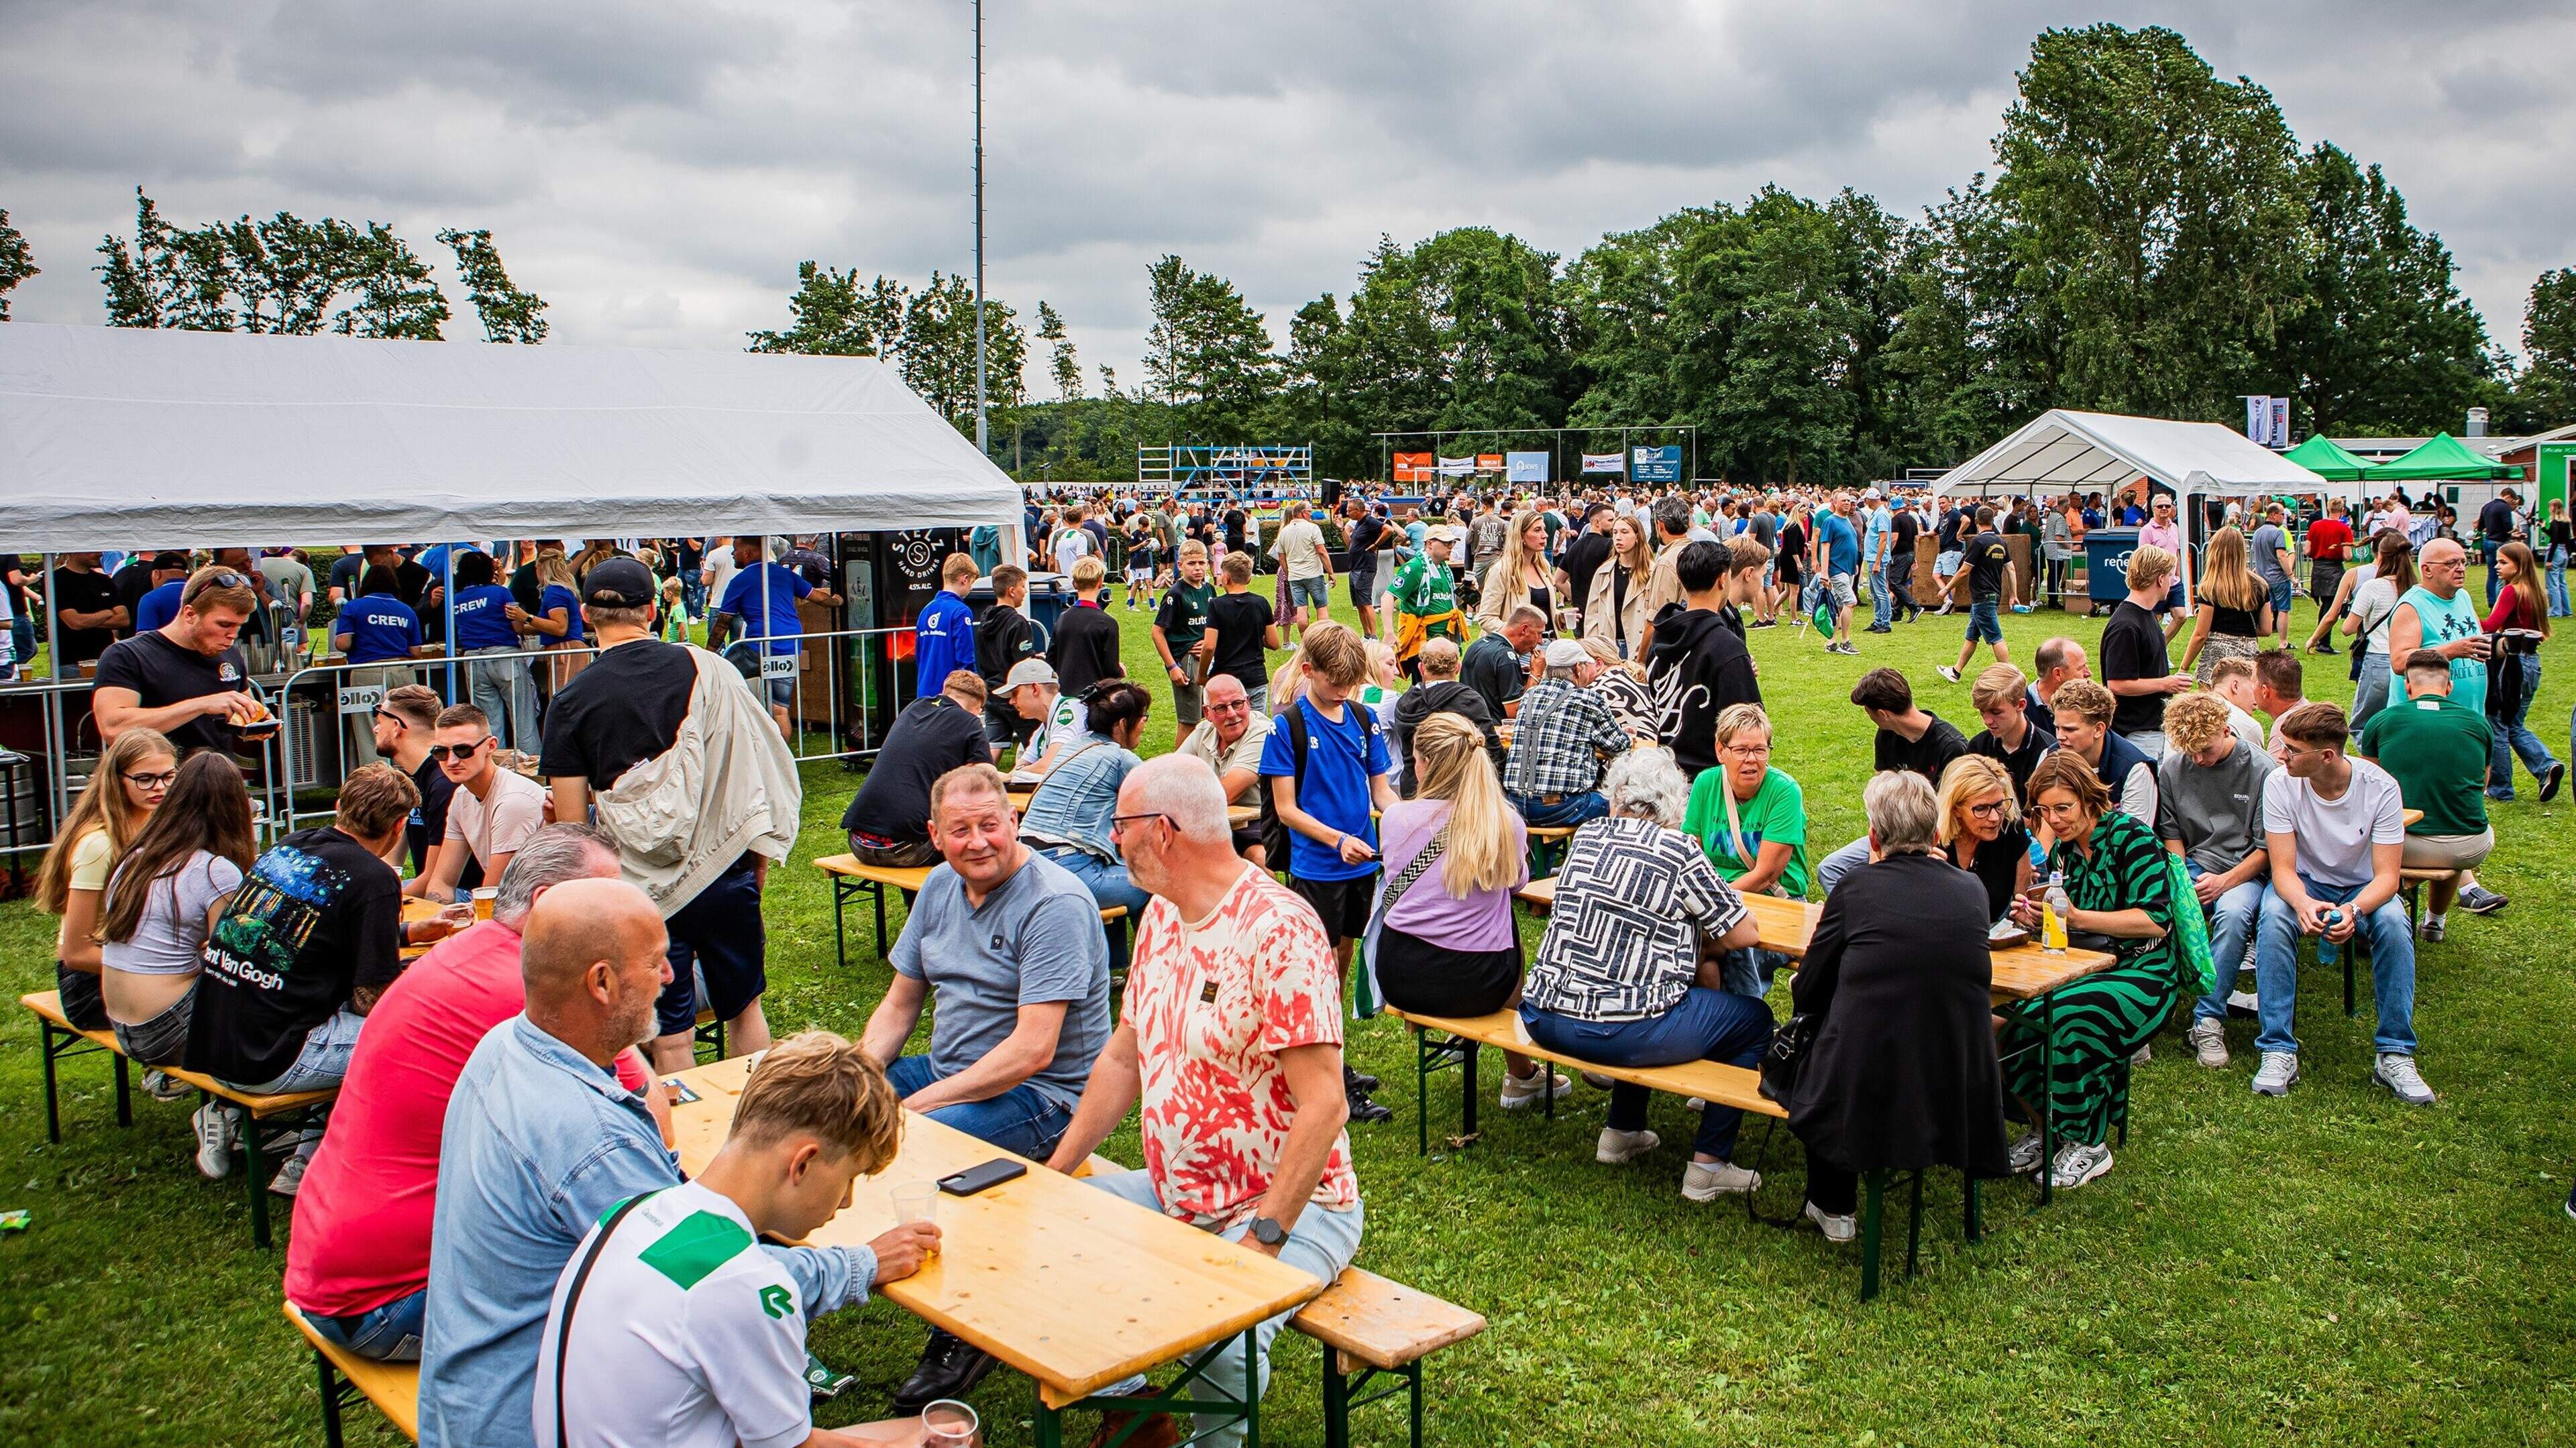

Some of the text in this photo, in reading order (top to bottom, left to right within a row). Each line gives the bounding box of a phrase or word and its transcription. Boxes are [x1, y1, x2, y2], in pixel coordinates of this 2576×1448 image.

[898, 559, 940, 578] HARD DRINKS
[367, 614, 409, 628] CREW
[1058, 713, 1073, 721] TOTO
[221, 950, 239, 974] Van
[239, 960, 284, 991] Gogh
